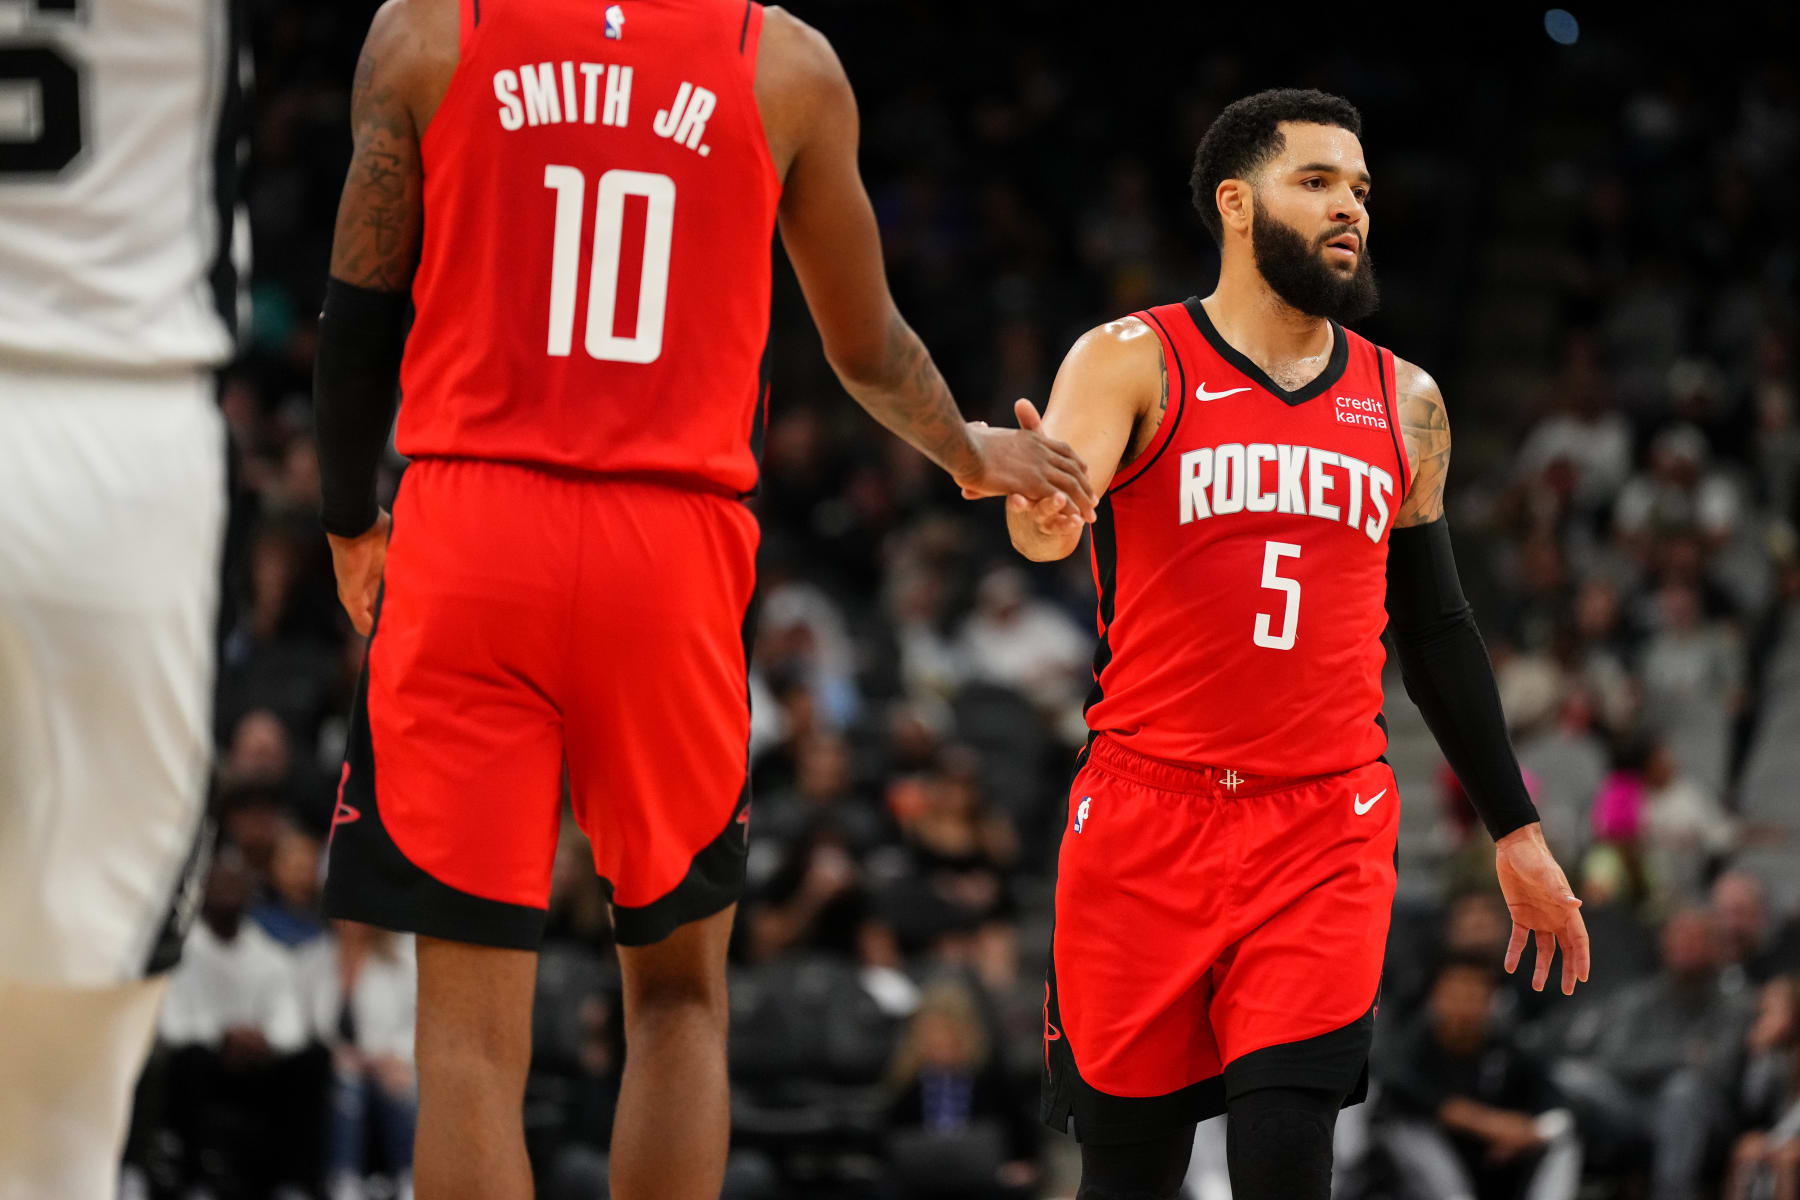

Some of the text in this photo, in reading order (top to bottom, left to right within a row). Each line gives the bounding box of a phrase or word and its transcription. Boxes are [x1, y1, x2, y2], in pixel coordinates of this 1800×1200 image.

[493, 61, 717, 157] SMITH JR.
[543, 164, 676, 364] 10
[1335, 396, 1384, 414] credit
[1335, 407, 1388, 430] karma
[1179, 442, 1394, 544] ROCKETS
[1253, 540, 1302, 651] 5
